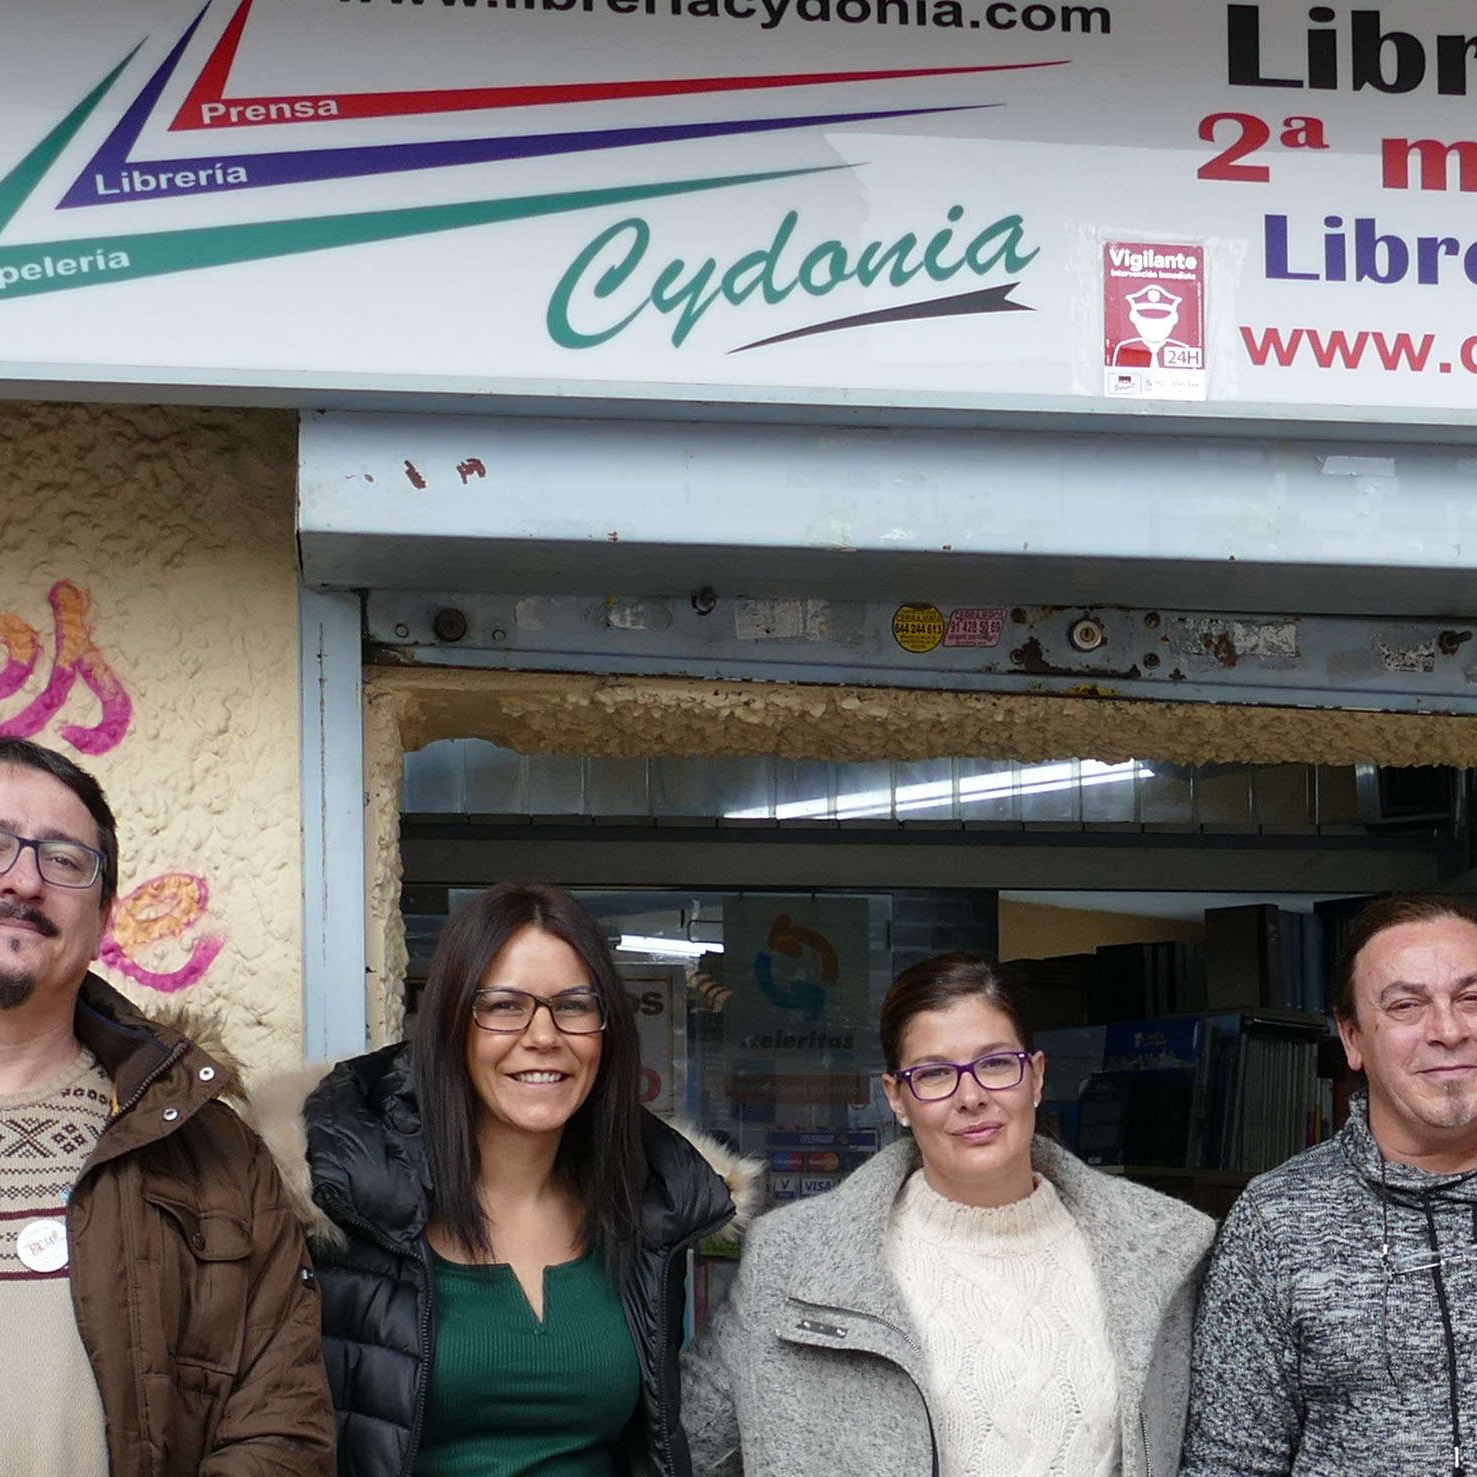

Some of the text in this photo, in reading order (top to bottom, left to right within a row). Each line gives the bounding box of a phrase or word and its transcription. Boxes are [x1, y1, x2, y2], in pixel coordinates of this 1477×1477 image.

[339, 0, 1113, 34] .acydonia.com
[201, 96, 340, 126] Prensa
[1196, 111, 1331, 184] 2ª
[95, 162, 249, 196] Librería
[1109, 248, 1198, 273] Vigilante
[545, 204, 1042, 350] Cydonia
[1167, 350, 1200, 365] 24H
[804, 1181, 832, 1191] VISA
